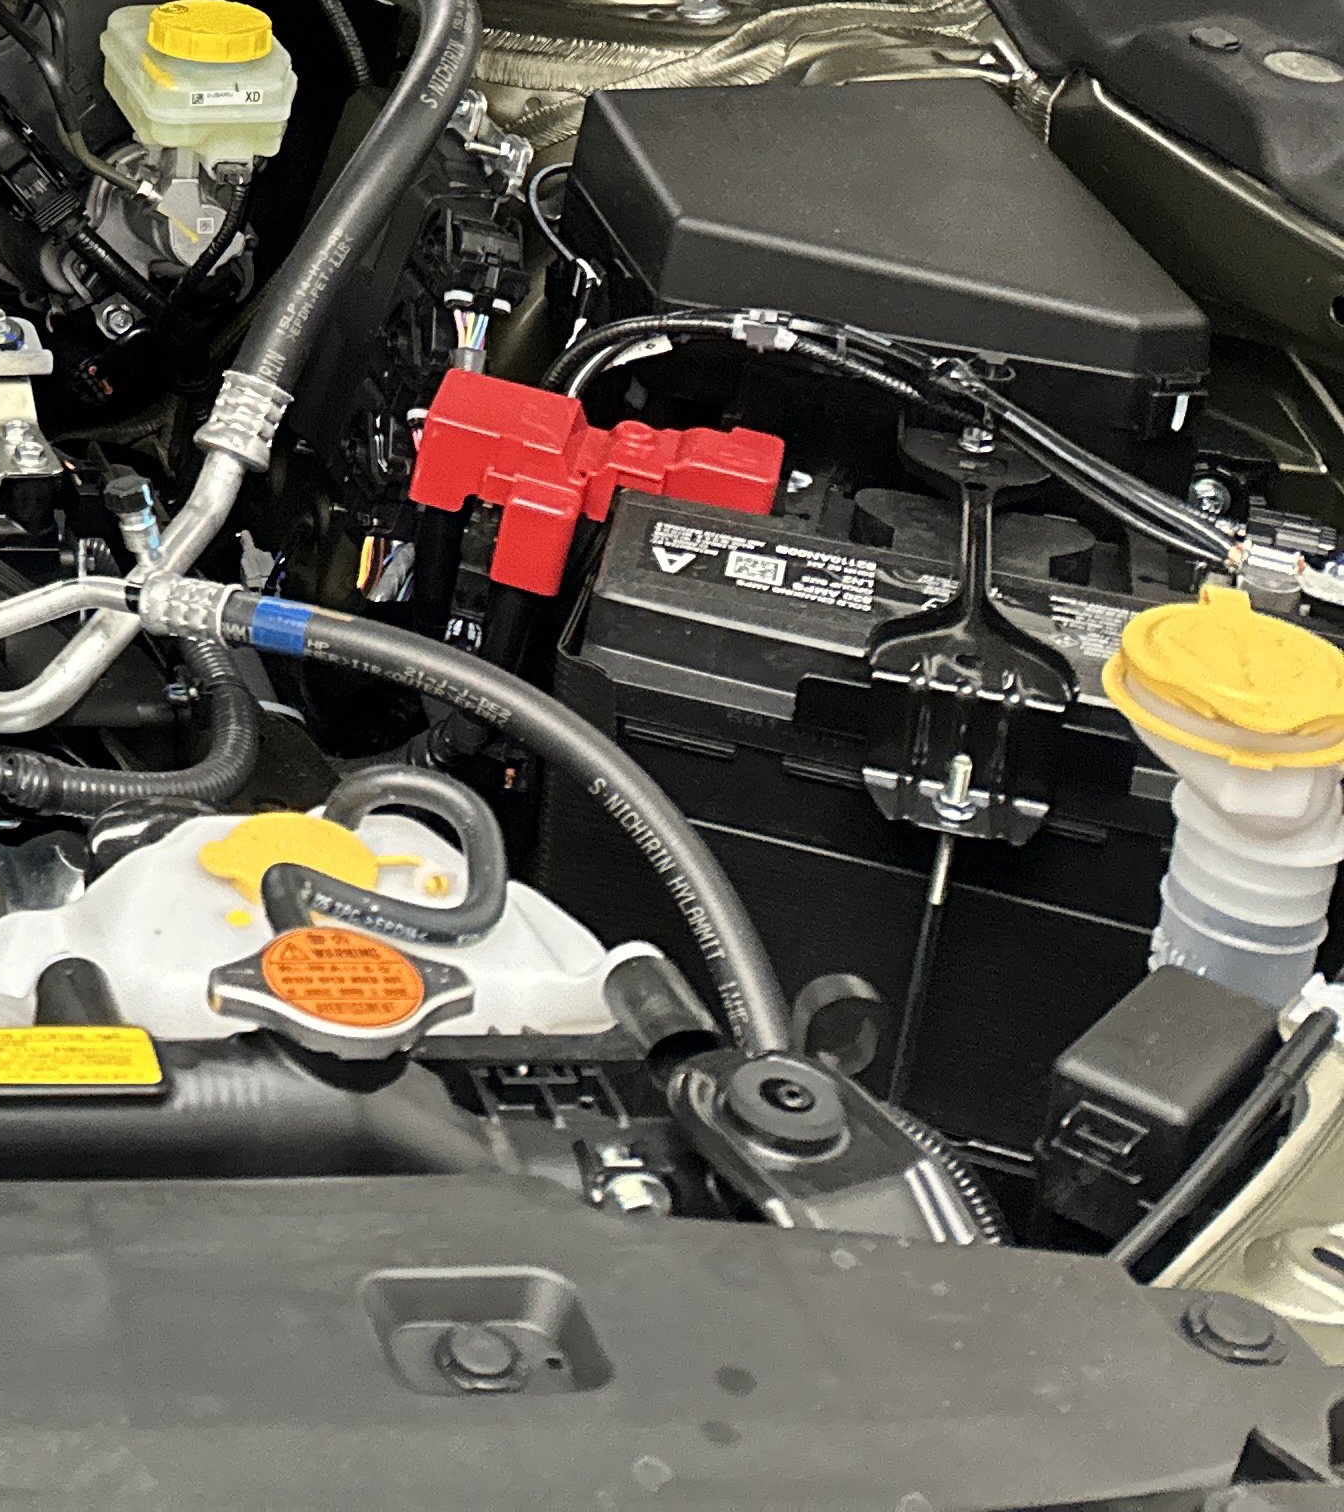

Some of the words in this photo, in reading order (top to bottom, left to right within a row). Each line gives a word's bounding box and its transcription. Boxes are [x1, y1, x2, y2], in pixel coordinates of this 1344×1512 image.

[245, 91, 261, 103] XD
[792, 581, 841, 599] AMPS
[666, 875, 725, 962] HYLAMMIT
